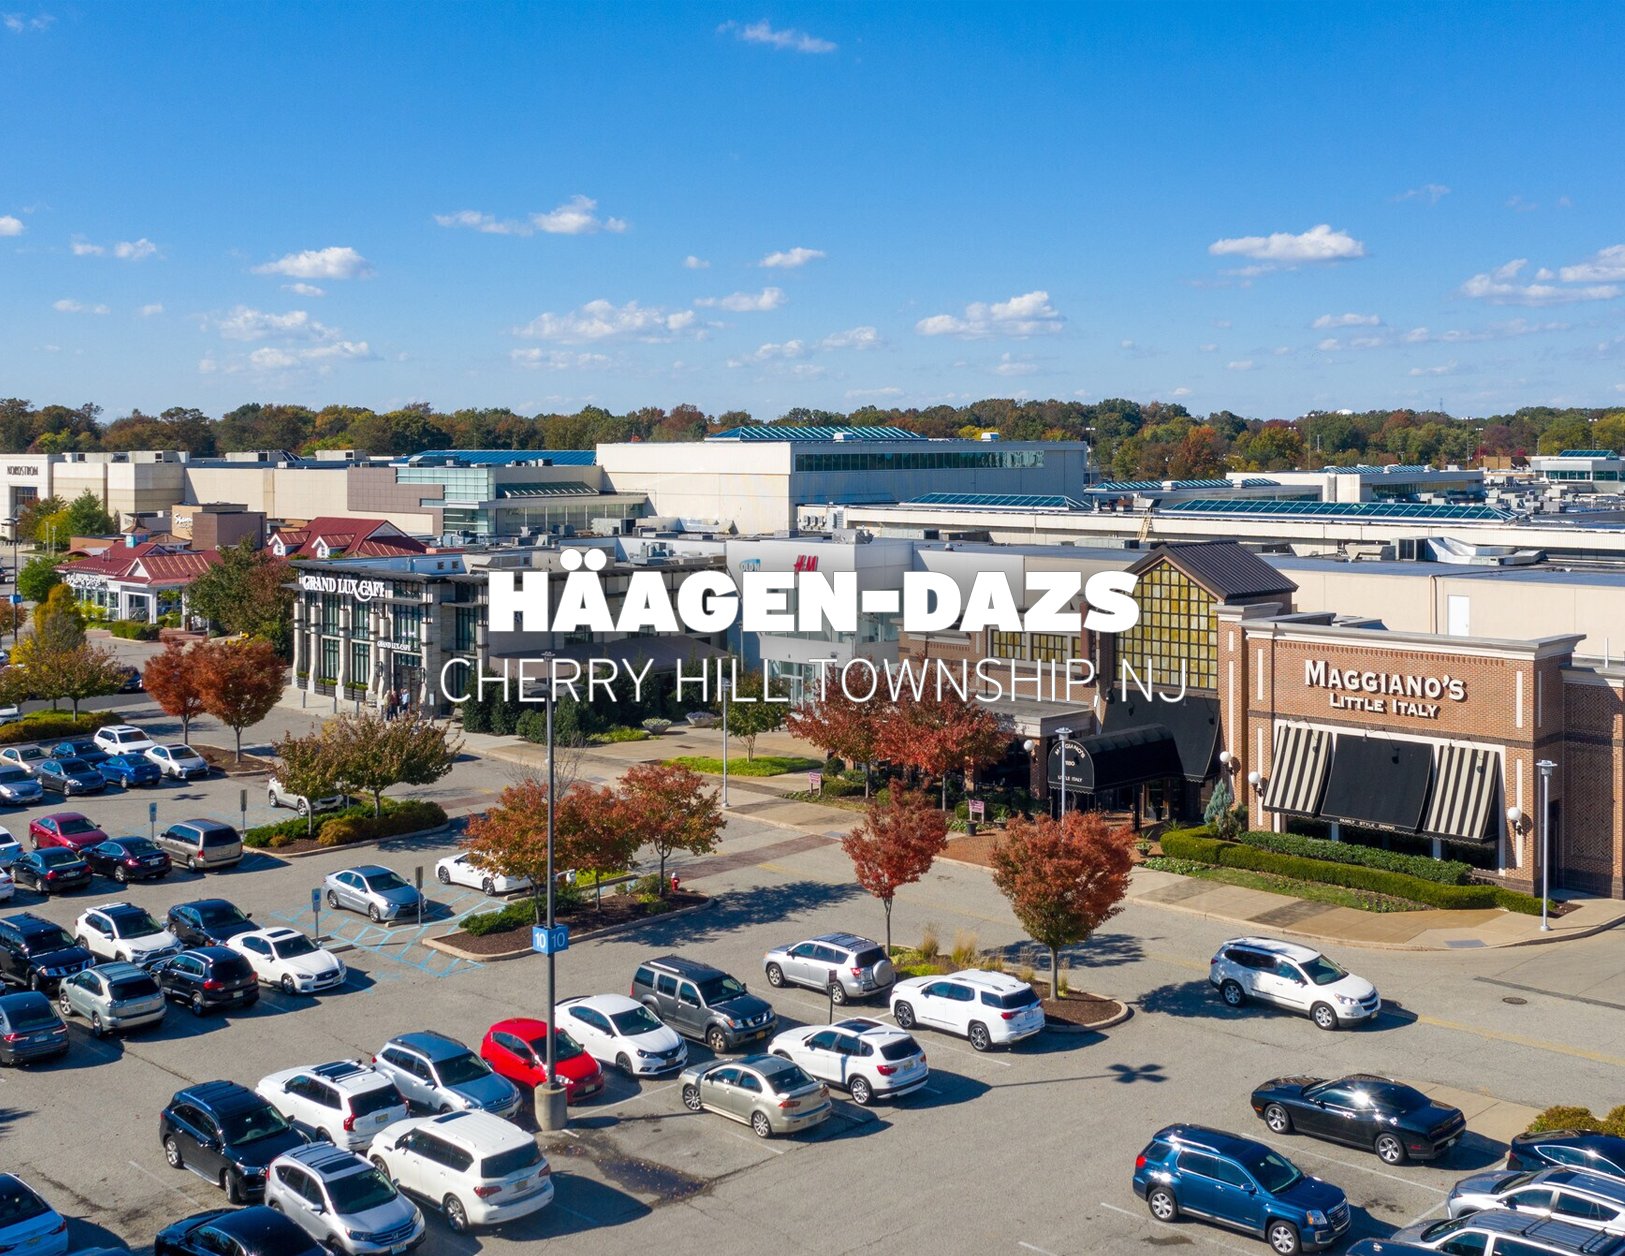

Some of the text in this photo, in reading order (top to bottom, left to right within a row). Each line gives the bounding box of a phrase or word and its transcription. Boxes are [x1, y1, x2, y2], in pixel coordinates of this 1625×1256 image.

[302, 575, 337, 593] GRAND
[337, 578, 360, 596] LUX
[1304, 659, 1468, 702] MAGGIANO'S
[1329, 692, 1440, 719] LITTLE ITALY
[535, 932, 547, 949] 10
[551, 932, 566, 949] 10
